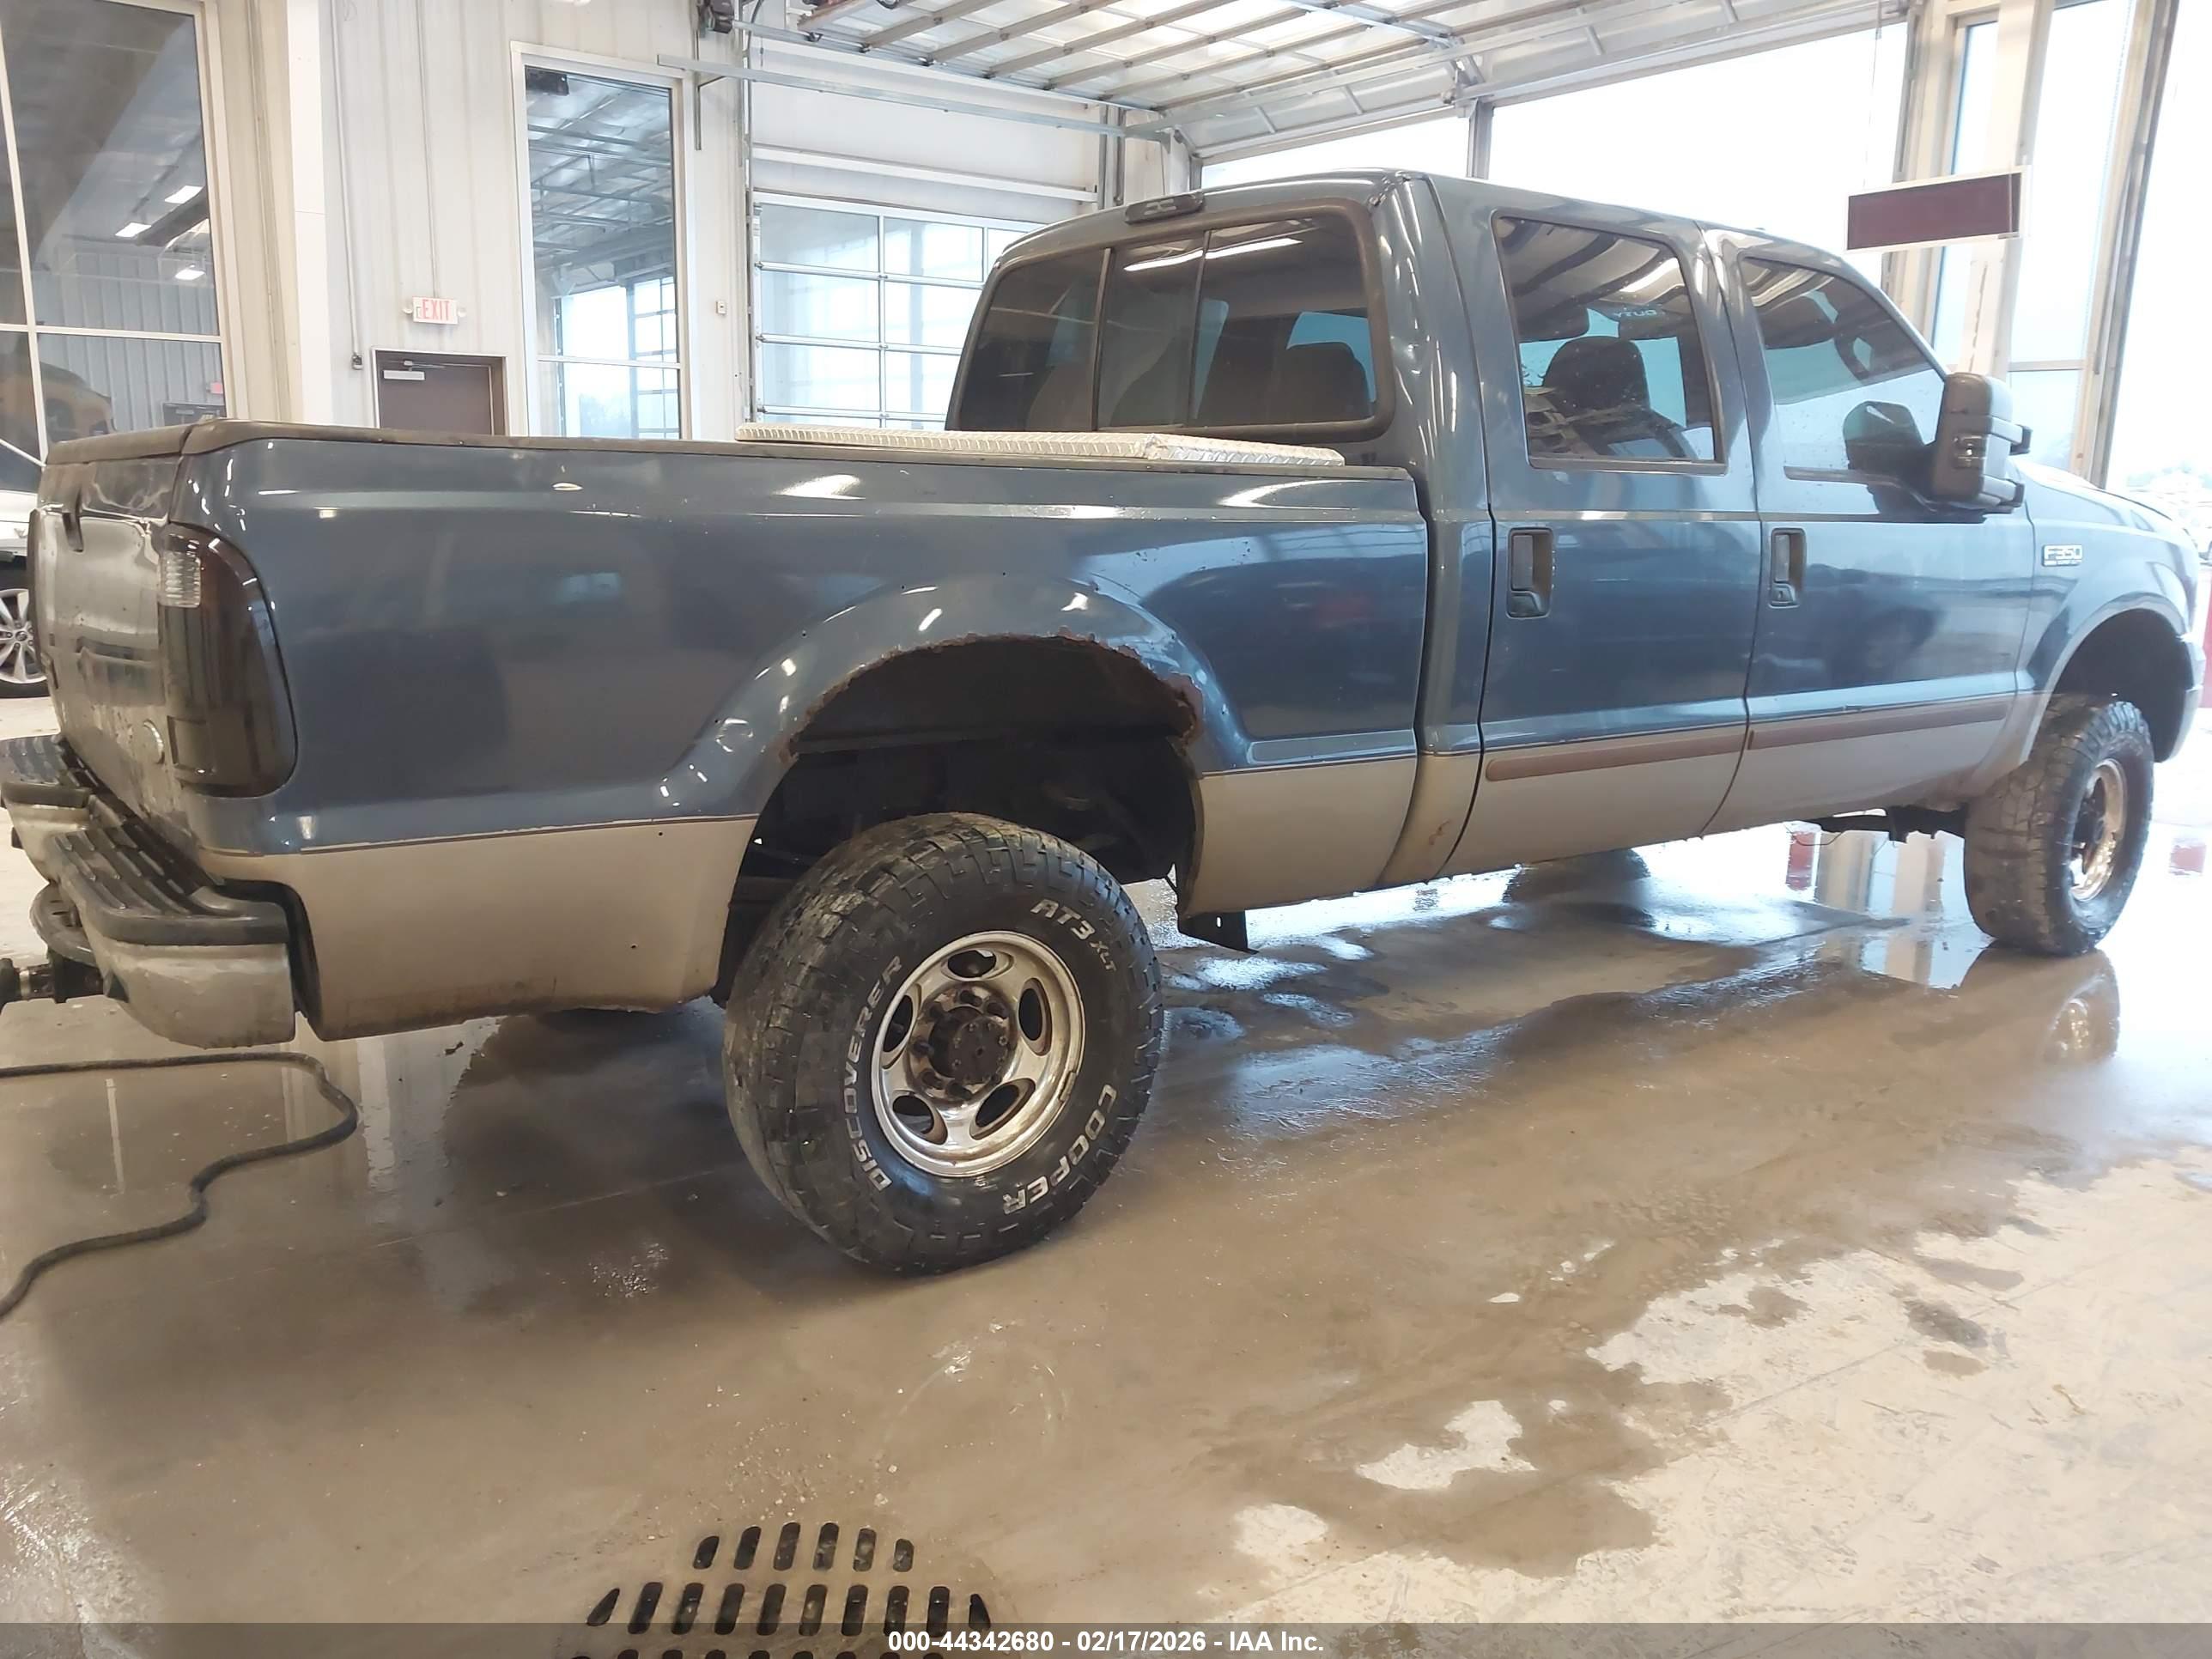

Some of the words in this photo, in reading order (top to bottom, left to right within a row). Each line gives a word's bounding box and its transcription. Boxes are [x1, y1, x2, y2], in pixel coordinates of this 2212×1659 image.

[422, 299, 451, 320] EXIT
[1031, 899, 1096, 939] AT3
[844, 956, 902, 1192] DISCOVERER
[1003, 1085, 1117, 1215] COOPER
